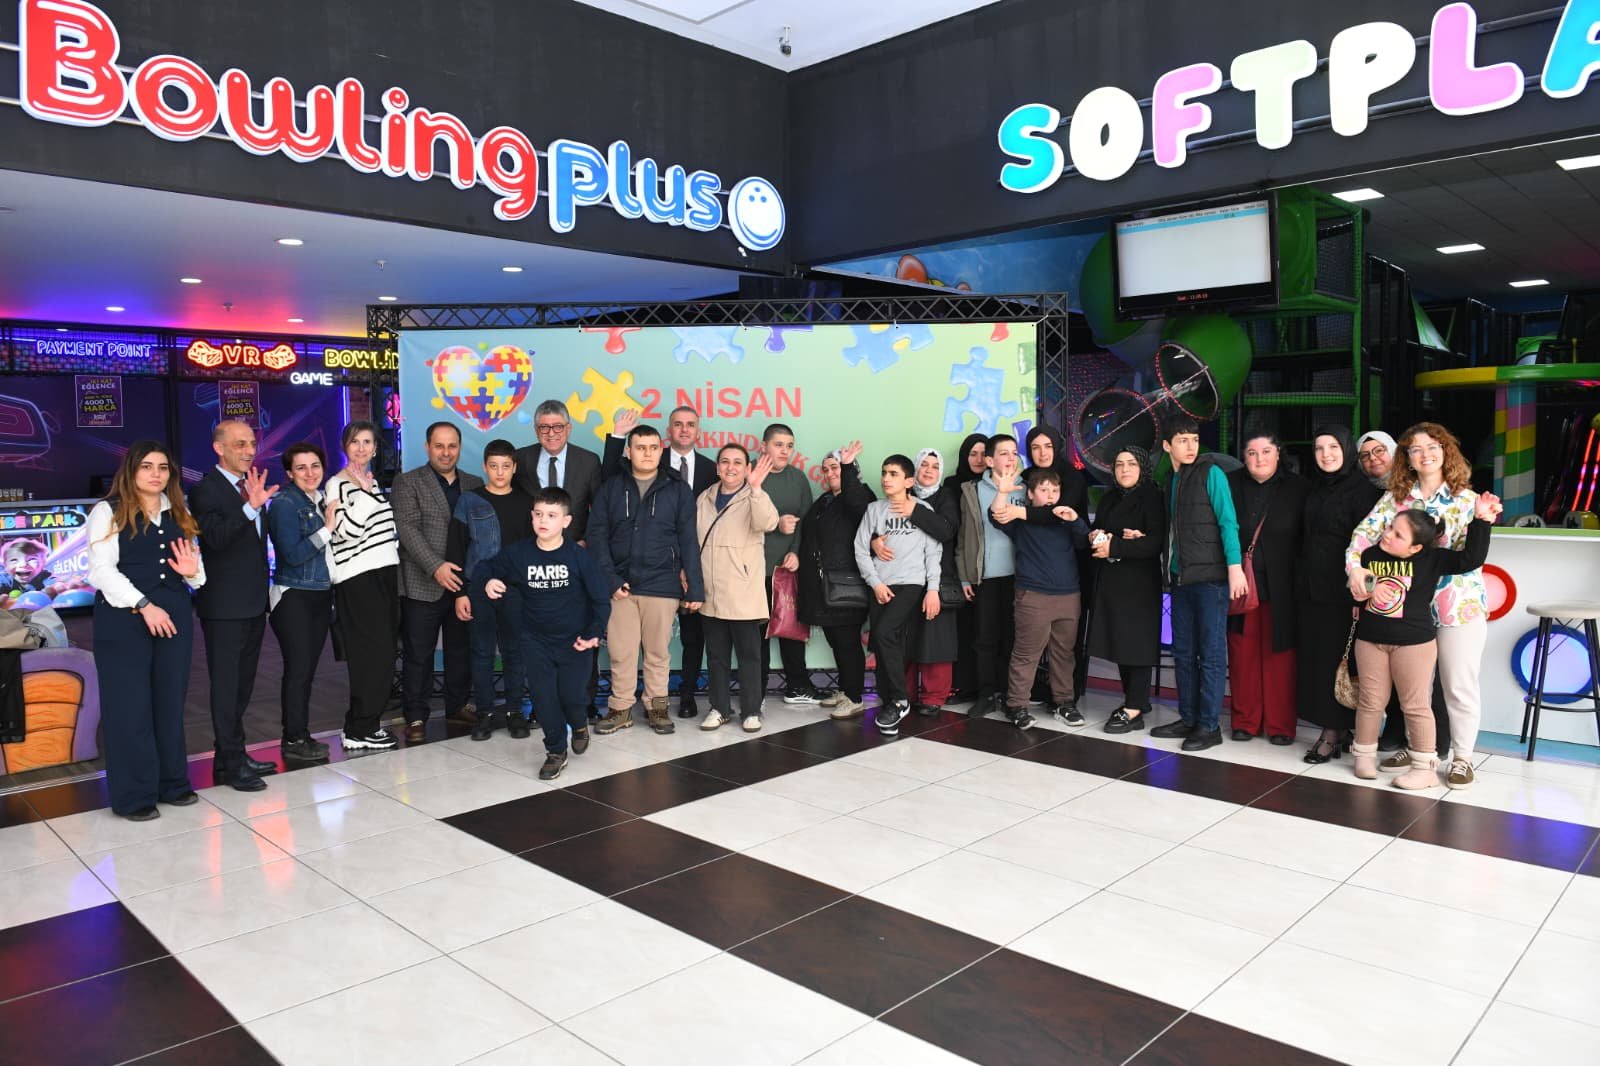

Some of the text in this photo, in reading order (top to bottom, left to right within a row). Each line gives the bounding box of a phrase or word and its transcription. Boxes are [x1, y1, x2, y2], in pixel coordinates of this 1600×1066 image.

[19, 0, 723, 234] Bowling plus
[37, 340, 151, 357] PAYMENT POINT
[222, 345, 260, 366] VR
[290, 372, 334, 386] GAME
[641, 381, 802, 418] 2 NİSAN
[84, 404, 117, 412] HARCA
[32, 513, 79, 528] PARK
[527, 564, 569, 580] PARIS
[527, 579, 569, 589] SINCE 1975
